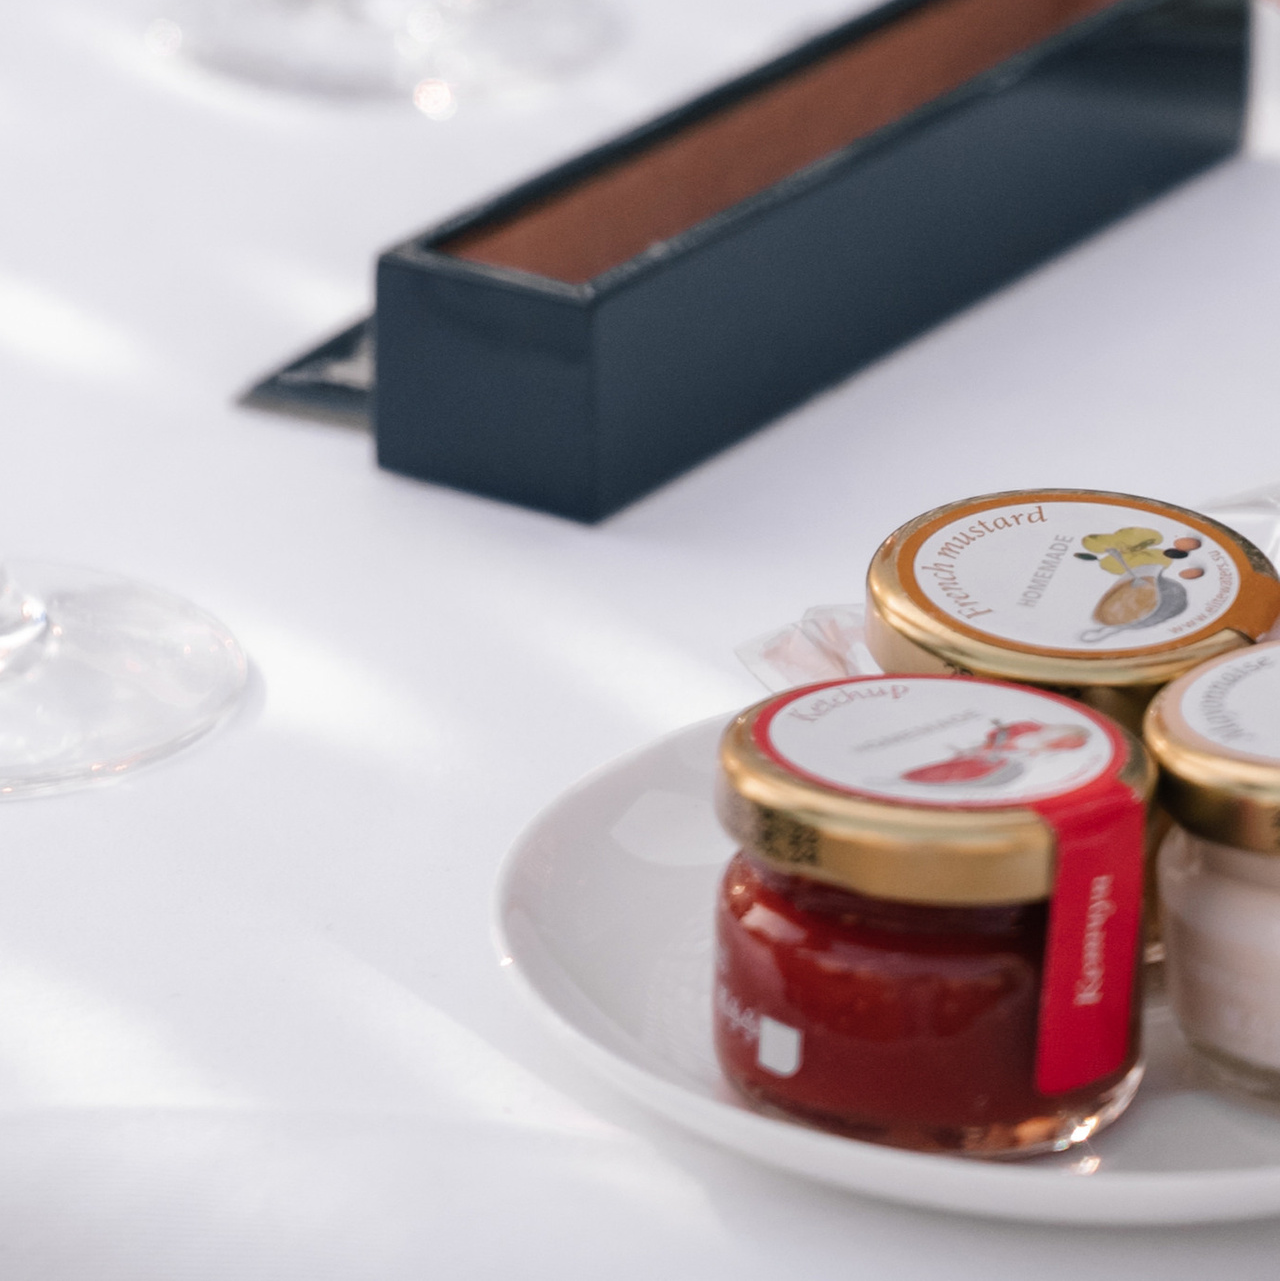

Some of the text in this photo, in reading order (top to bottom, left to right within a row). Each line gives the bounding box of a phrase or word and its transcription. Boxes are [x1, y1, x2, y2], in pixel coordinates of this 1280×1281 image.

[921, 505, 1048, 619] French mustard
[1018, 534, 1074, 608] HOMEMADE
[788, 684, 911, 723] Ketchup
